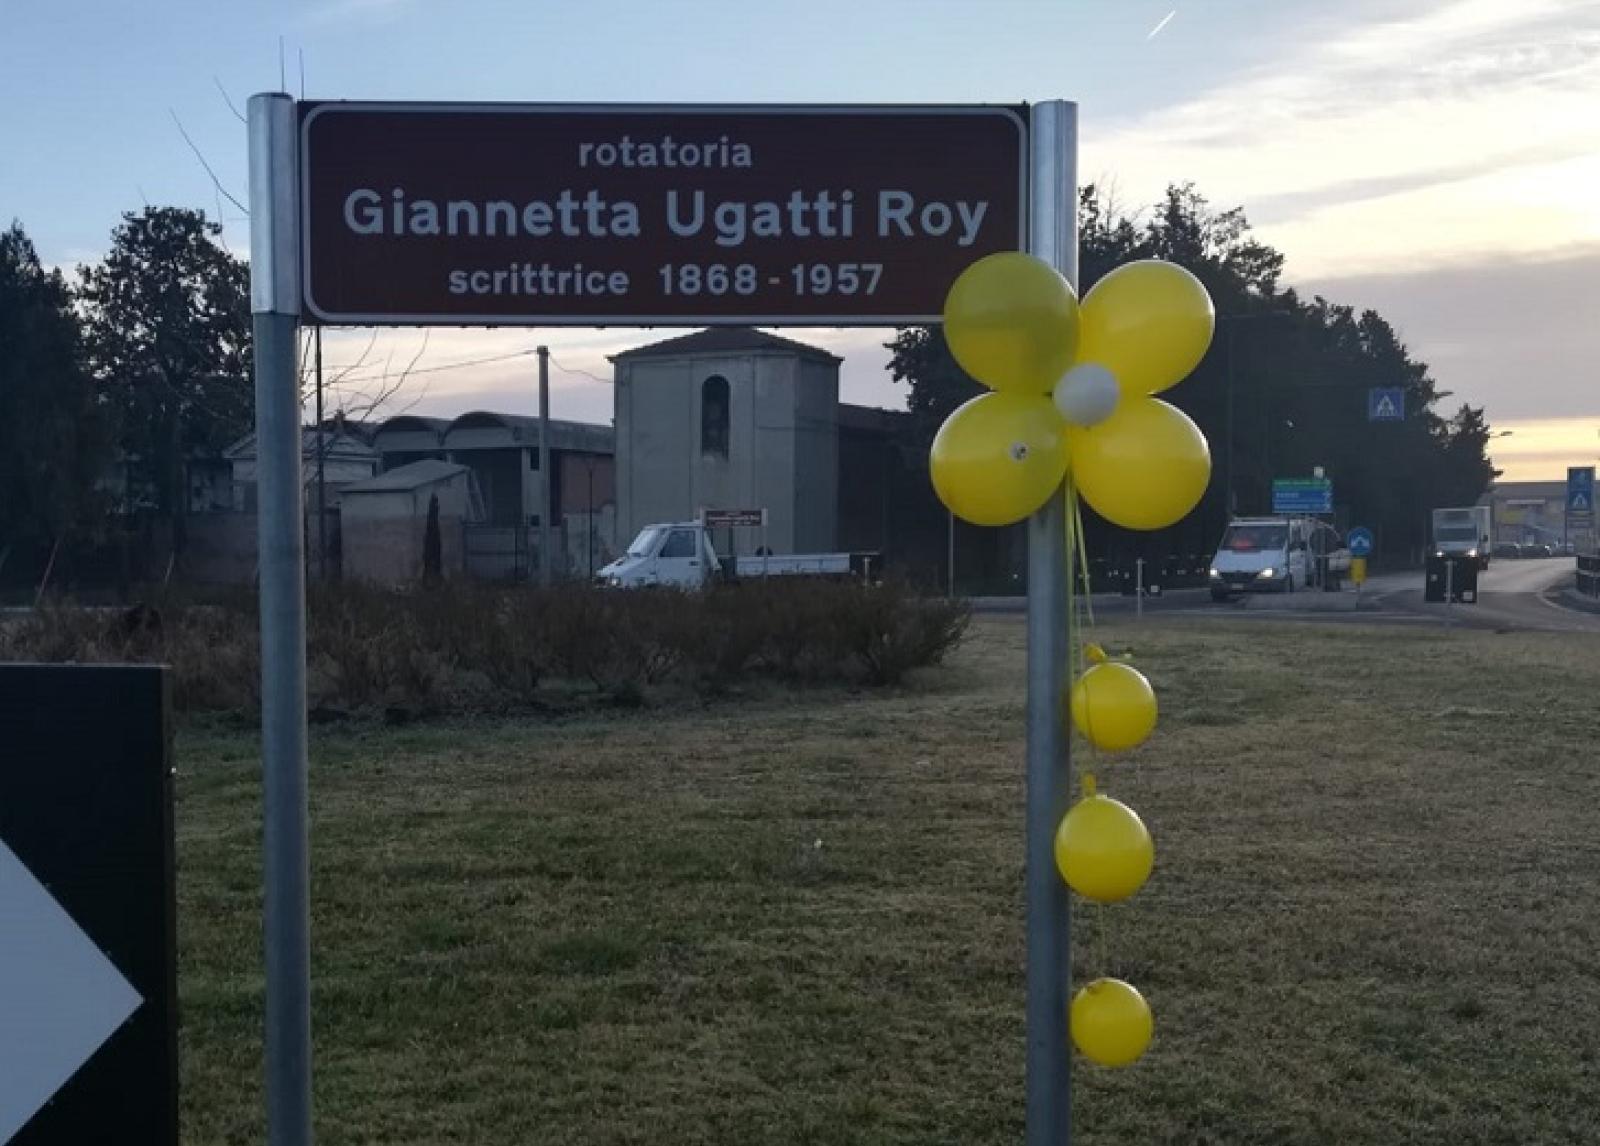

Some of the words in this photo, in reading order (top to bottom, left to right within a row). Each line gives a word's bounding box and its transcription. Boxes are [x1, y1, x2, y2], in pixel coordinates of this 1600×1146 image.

[578, 135, 752, 168] rotatoria
[343, 188, 642, 237] Giannetta
[665, 189, 855, 246] Ugatti
[876, 190, 989, 246] Roy
[448, 263, 630, 296] scrittrice
[658, 263, 757, 296] 1868
[790, 263, 884, 296] 1957
